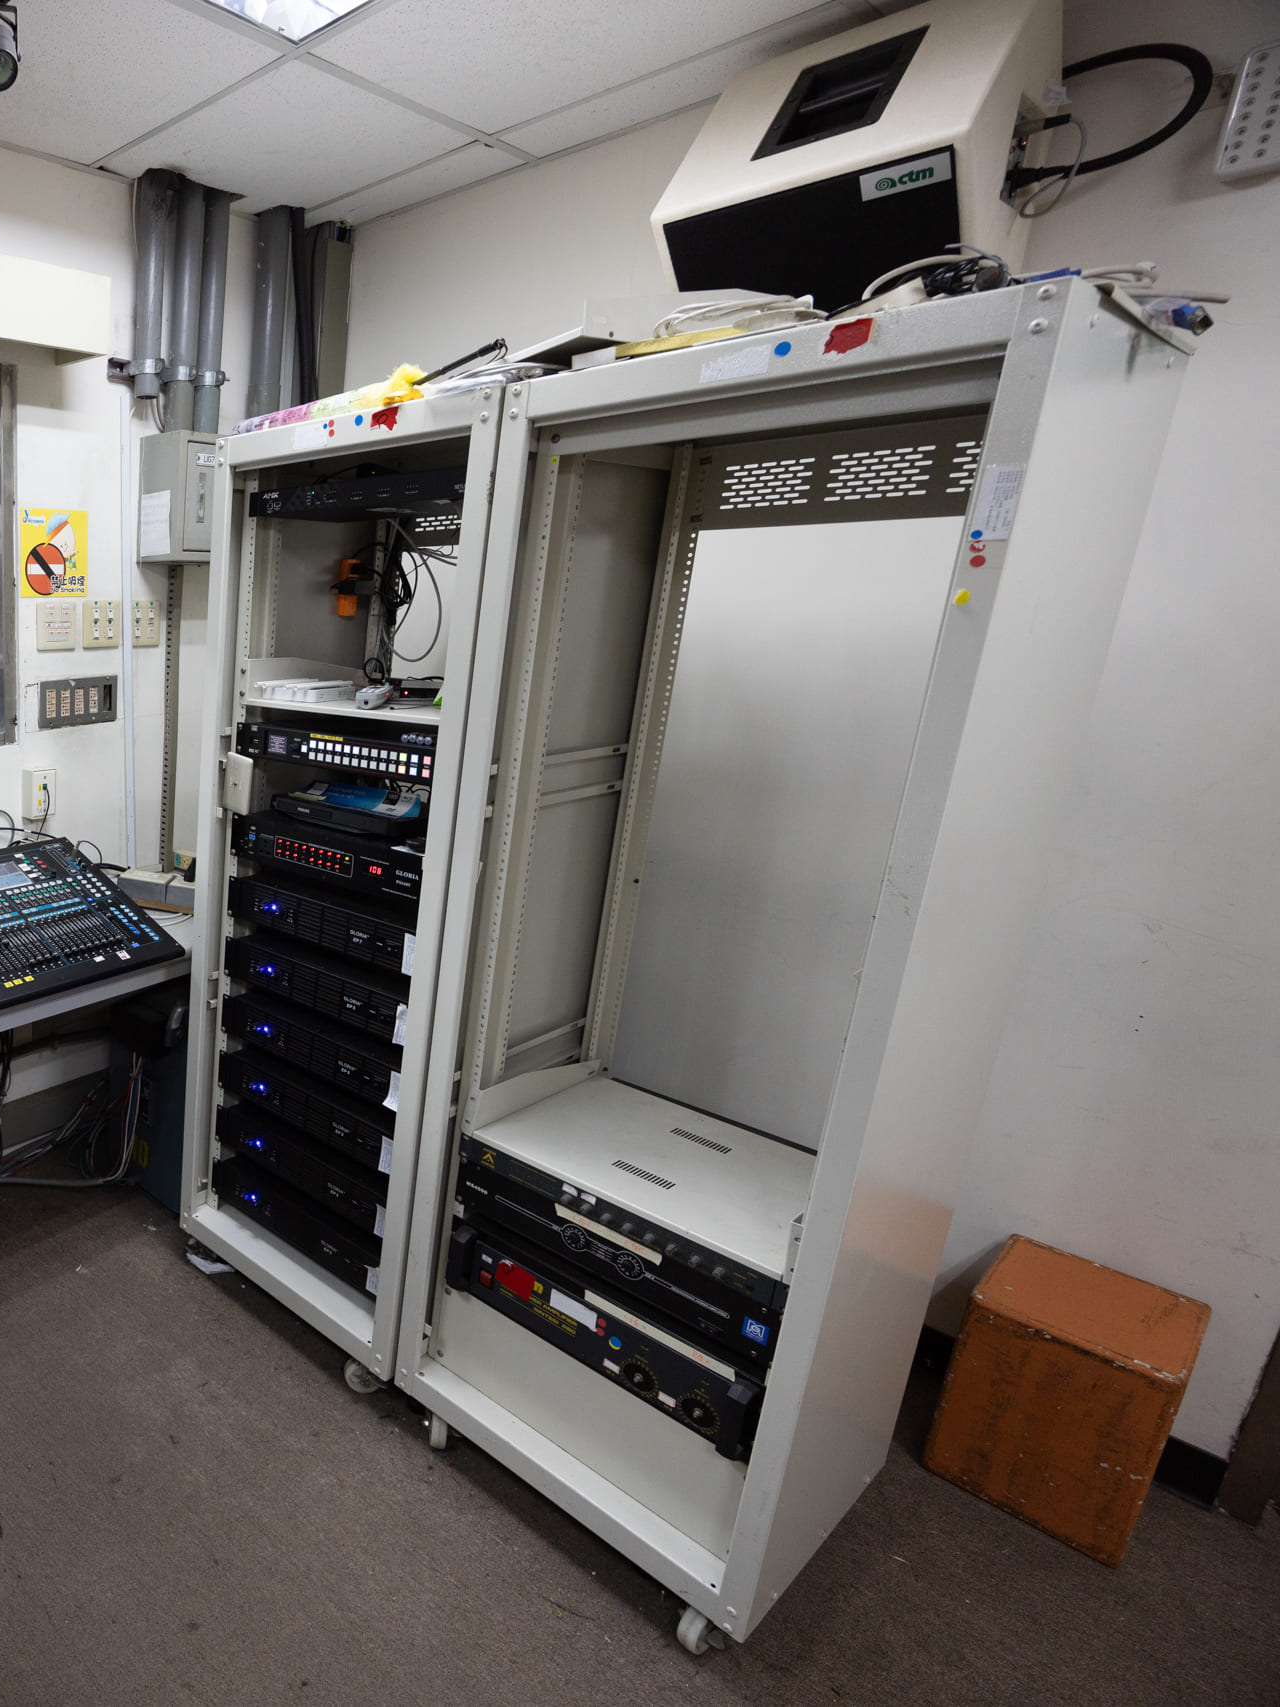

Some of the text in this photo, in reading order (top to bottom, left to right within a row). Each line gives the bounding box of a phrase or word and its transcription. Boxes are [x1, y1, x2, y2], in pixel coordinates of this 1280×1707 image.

[51, 575, 85, 587] 禁止吸煙
[395, 868, 419, 881] GLORIA
